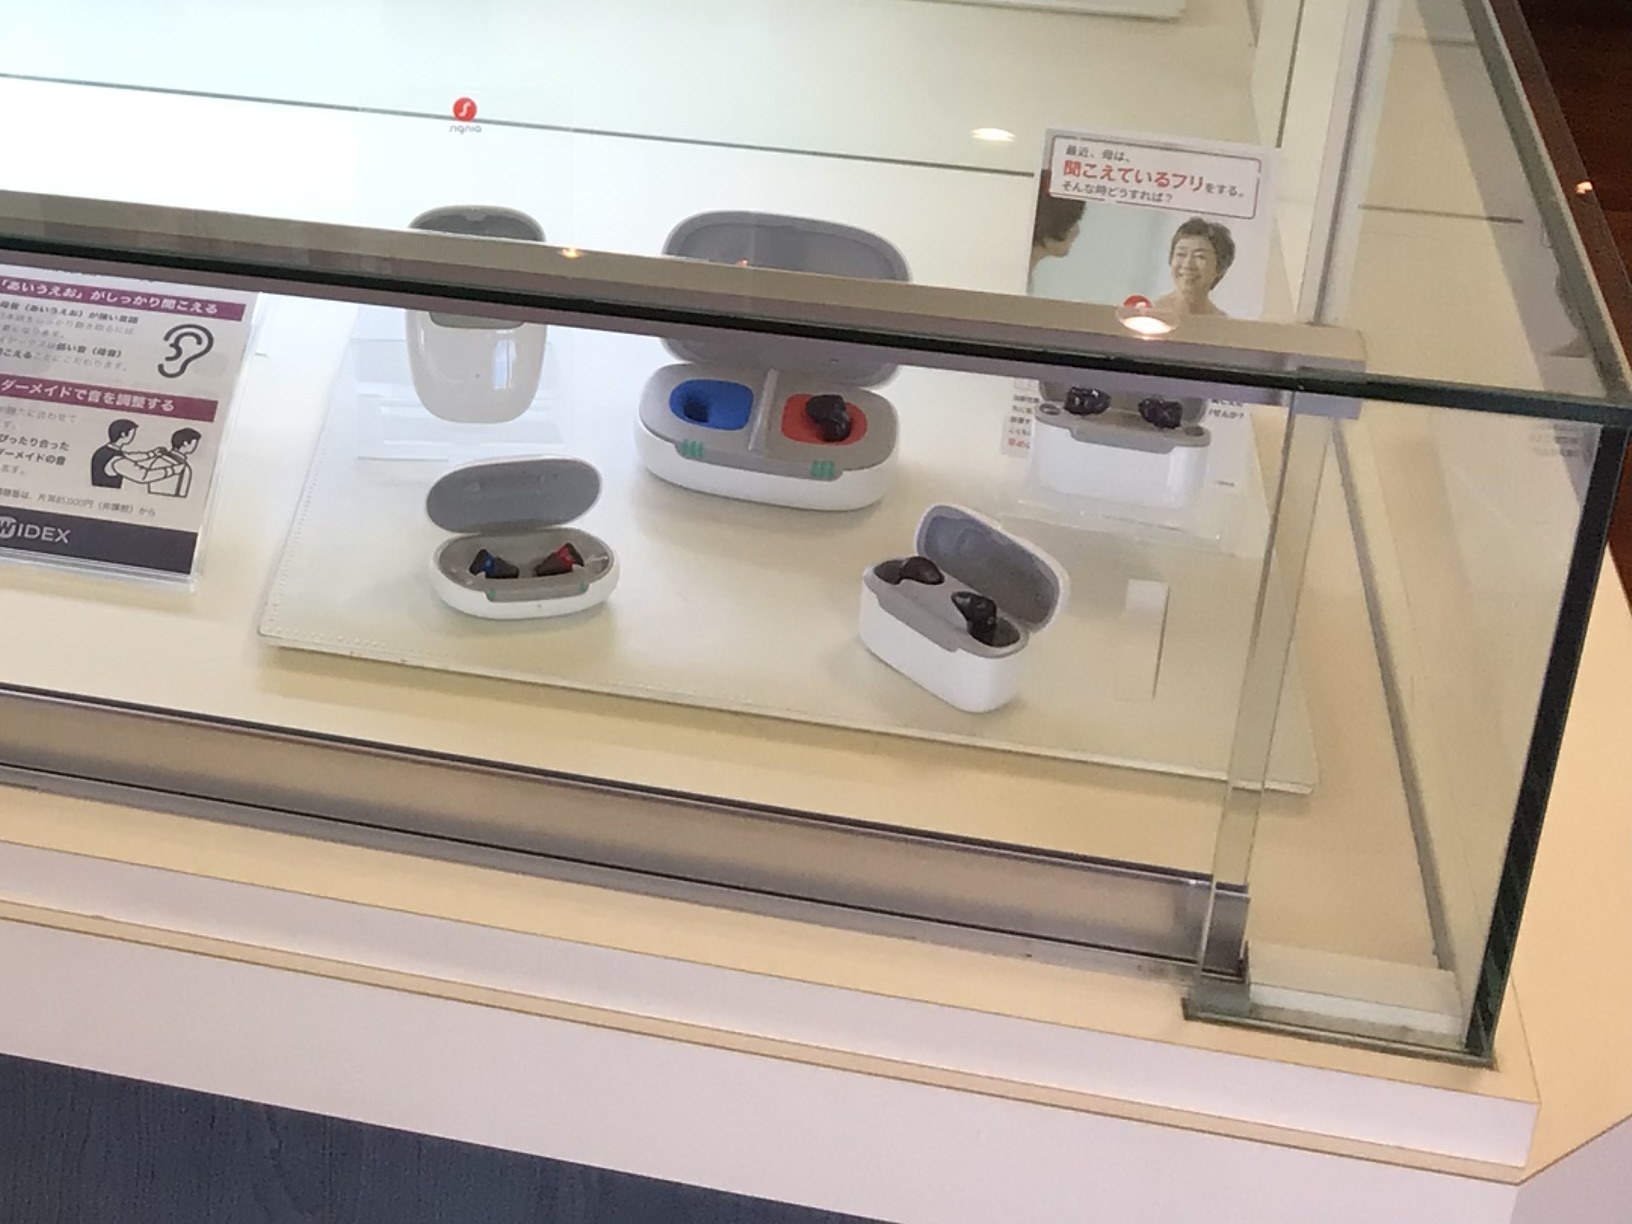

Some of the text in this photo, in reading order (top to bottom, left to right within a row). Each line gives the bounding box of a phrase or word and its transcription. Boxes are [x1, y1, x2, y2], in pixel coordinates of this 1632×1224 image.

[449, 124, 482, 135] signia
[1063, 159, 1244, 198] 聞こえているフリをする。
